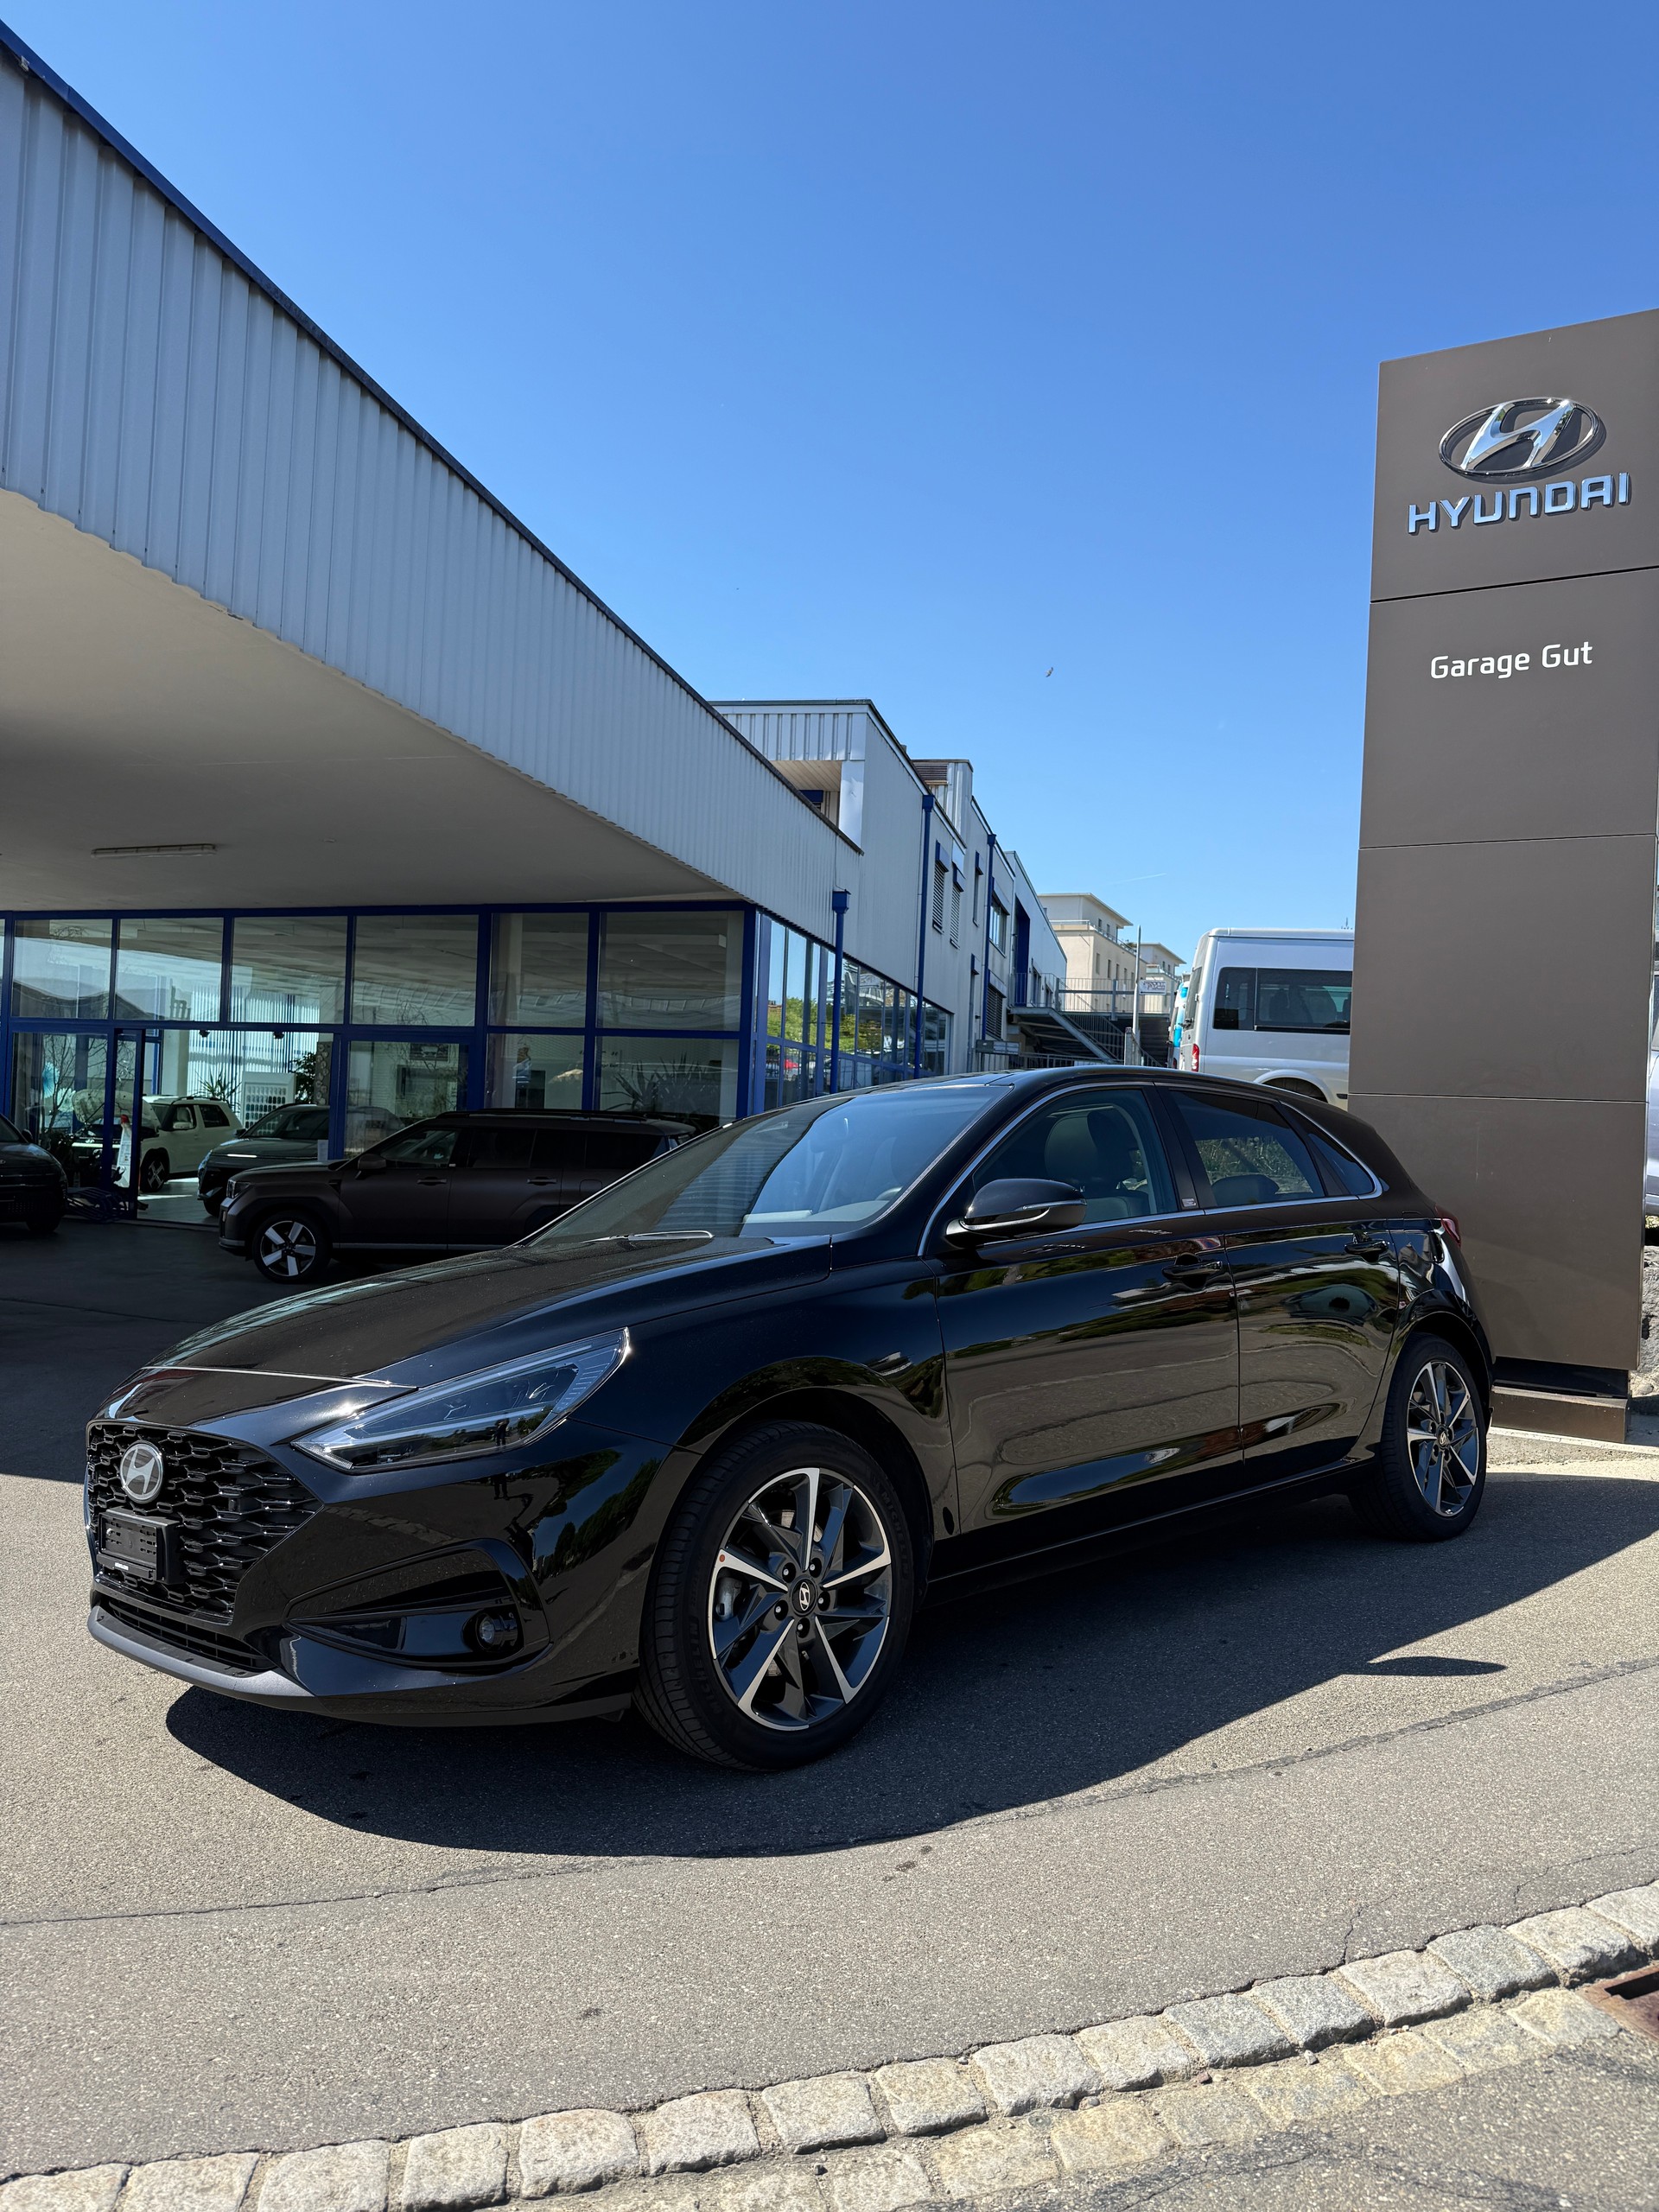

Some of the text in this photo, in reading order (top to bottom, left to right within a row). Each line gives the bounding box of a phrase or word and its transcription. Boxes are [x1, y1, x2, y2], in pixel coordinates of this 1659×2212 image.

[1408, 473, 1630, 533] HYUNDAI
[1431, 641, 1592, 679] Garage Gut
[881, 1490, 910, 1580] MICHELIN
[689, 1621, 723, 1714] MICHELIN
